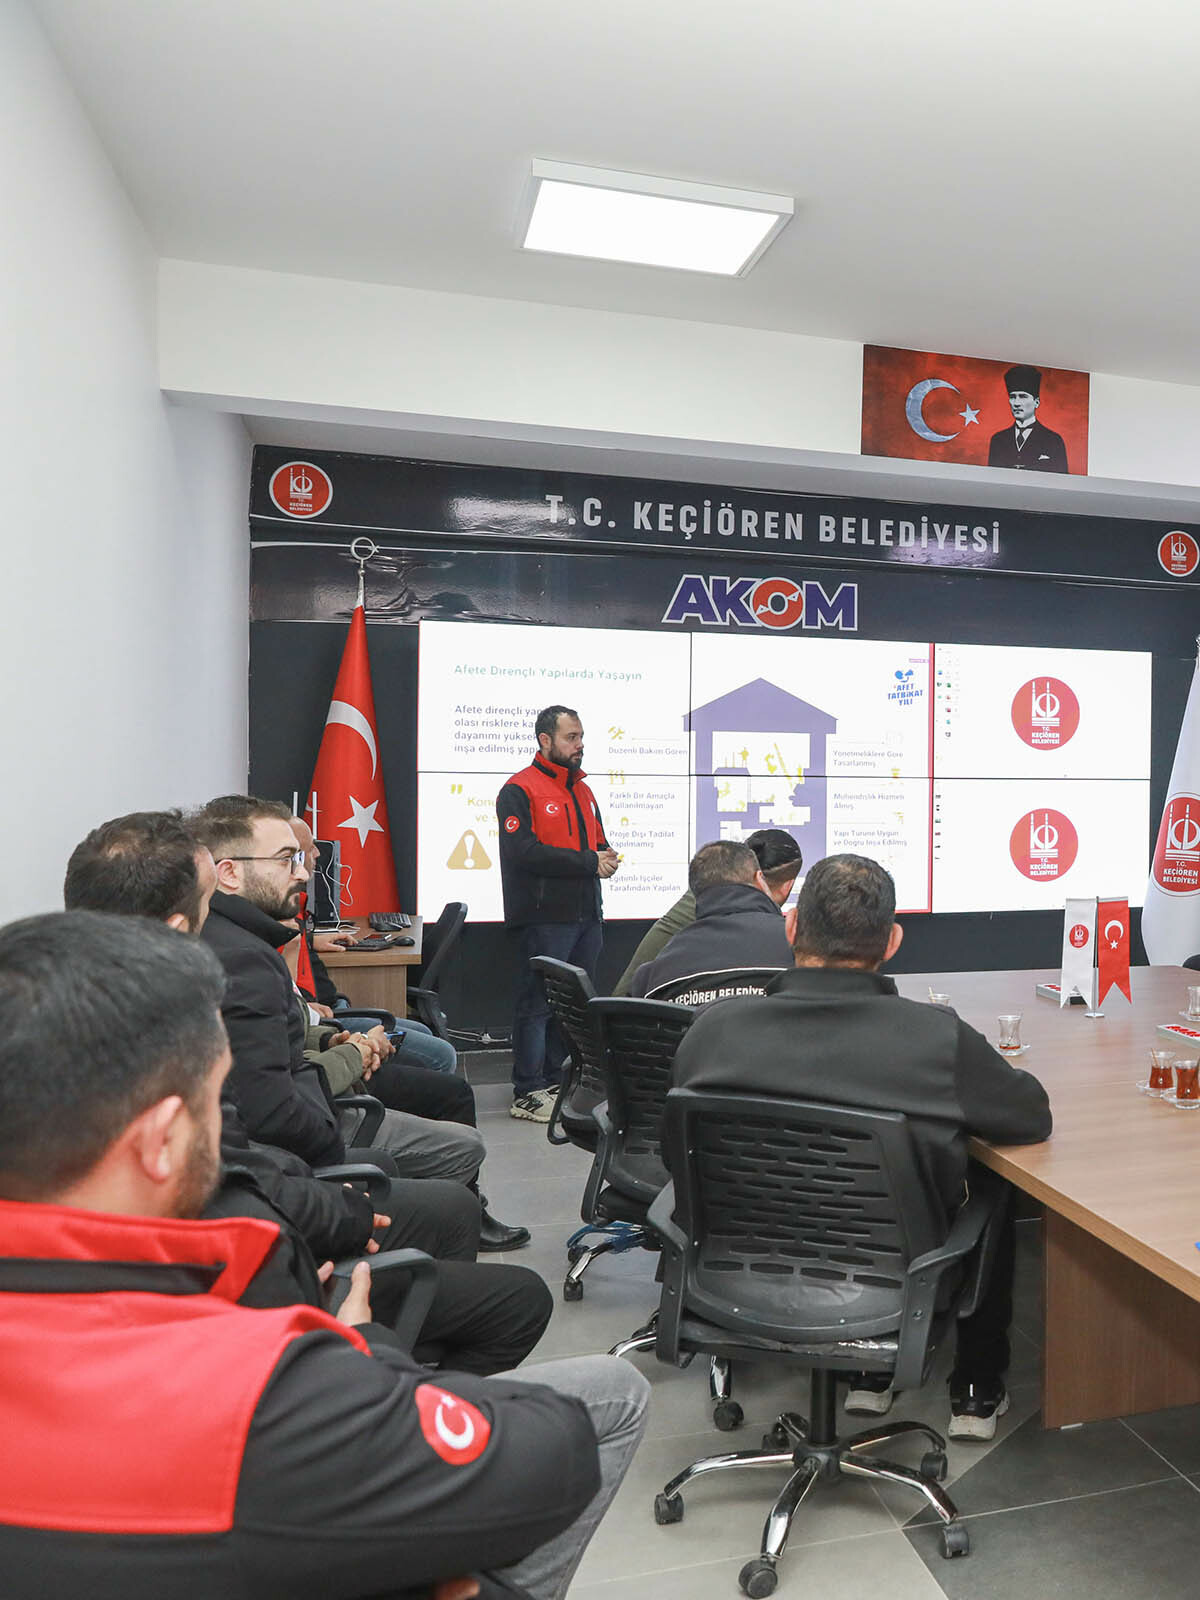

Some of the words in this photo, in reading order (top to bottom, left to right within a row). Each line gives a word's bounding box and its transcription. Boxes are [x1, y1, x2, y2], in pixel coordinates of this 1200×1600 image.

[633, 499, 803, 541] KEÇİÖREN
[819, 514, 1000, 554] BELEDİYESİ
[661, 573, 858, 631] AKOM
[454, 704, 483, 714] Afete
[1163, 867, 1199, 877] KEÇİÖREN
[1162, 875, 1198, 885] BELEDİYESİ
